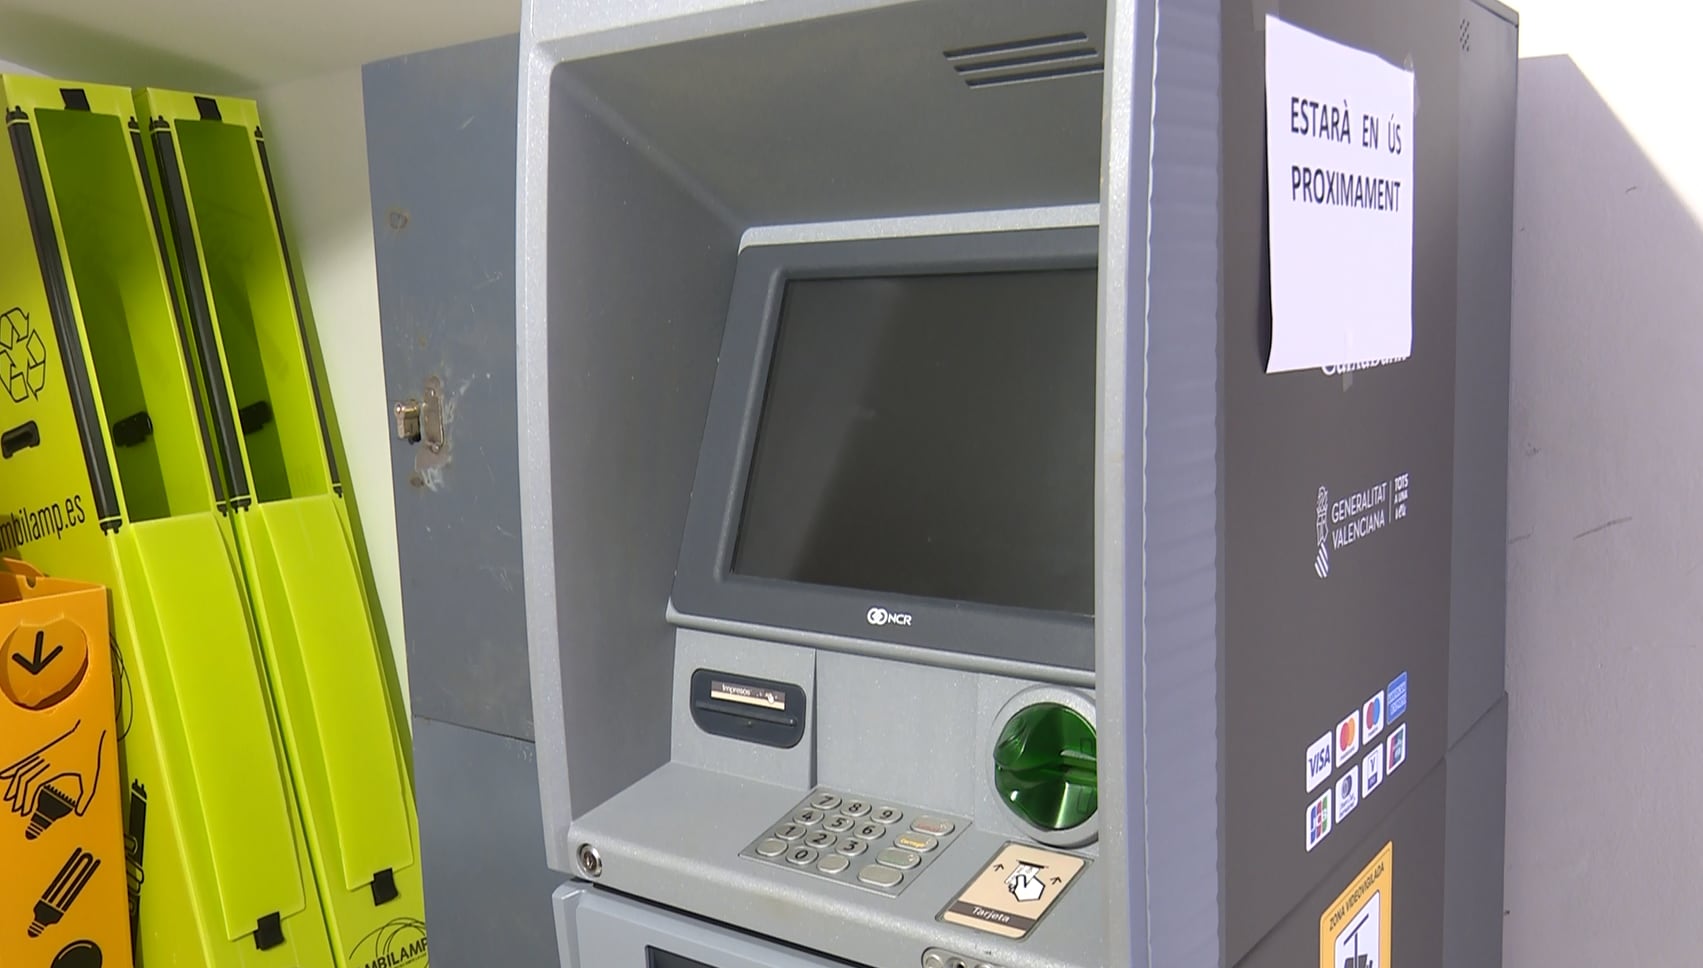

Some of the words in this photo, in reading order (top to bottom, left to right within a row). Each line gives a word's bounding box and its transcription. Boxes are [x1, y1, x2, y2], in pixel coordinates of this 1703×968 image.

[1291, 96, 1351, 145] ESTARÀ
[1362, 114, 1379, 150] EN
[1387, 113, 1402, 155] ÚS
[1291, 165, 1401, 212] PROXIMAMENT
[1394, 472, 1409, 492] TOTS
[1331, 482, 1387, 523] GENERALITAT
[0, 494, 86, 553] mbilamp.es
[1332, 509, 1386, 550] VALENCIANA
[888, 613, 912, 626] NCR
[1308, 744, 1331, 778] VISA
[819, 795, 834, 805] 7
[848, 802, 862, 813] 8
[879, 809, 893, 820] 9
[802, 811, 813, 821] 4
[831, 817, 846, 828] 5
[862, 825, 876, 835] 6
[785, 826, 796, 836] 1
[813, 833, 828, 844] 2
[843, 840, 859, 851] 3
[795, 849, 809, 860] 0
[1329, 905, 1346, 932] ZONA
[1345, 861, 1385, 913] VIDEOVIGILADA
[971, 906, 1011, 924] Tarjeta
